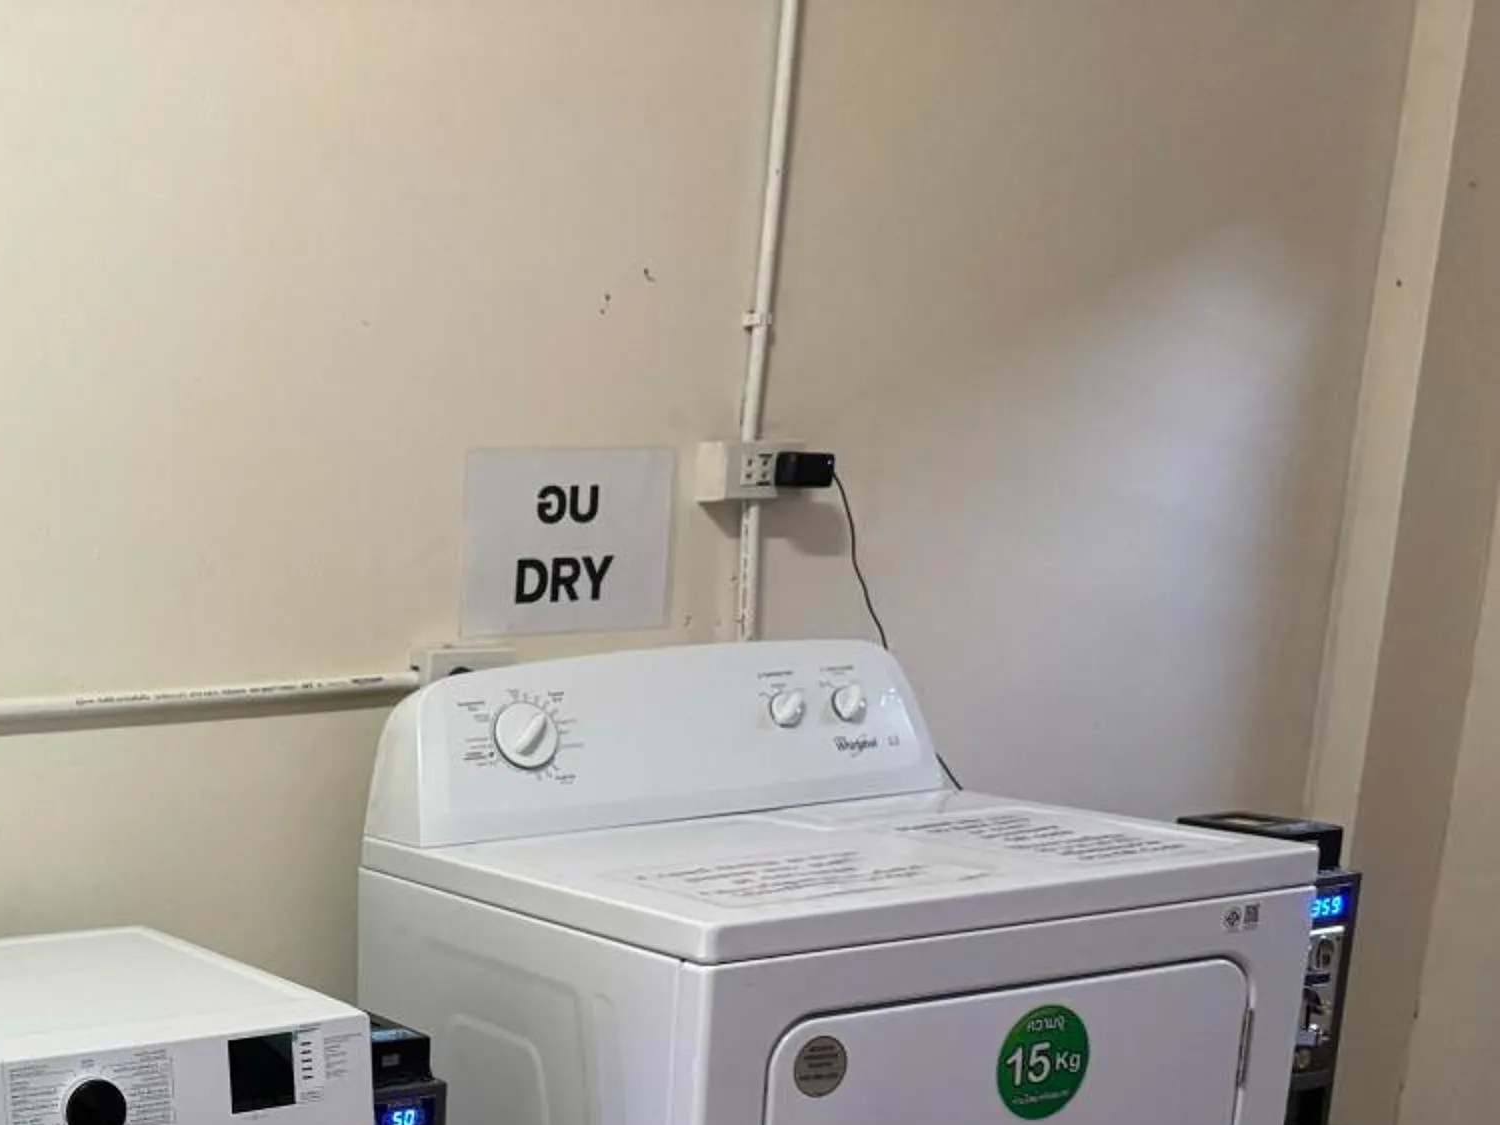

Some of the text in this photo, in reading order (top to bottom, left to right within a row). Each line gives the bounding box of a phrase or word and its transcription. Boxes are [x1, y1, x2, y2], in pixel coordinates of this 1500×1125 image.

[537, 484, 600, 524] อบ
[515, 555, 614, 604] DRY
[1005, 1041, 1081, 1087] 15 Kg
